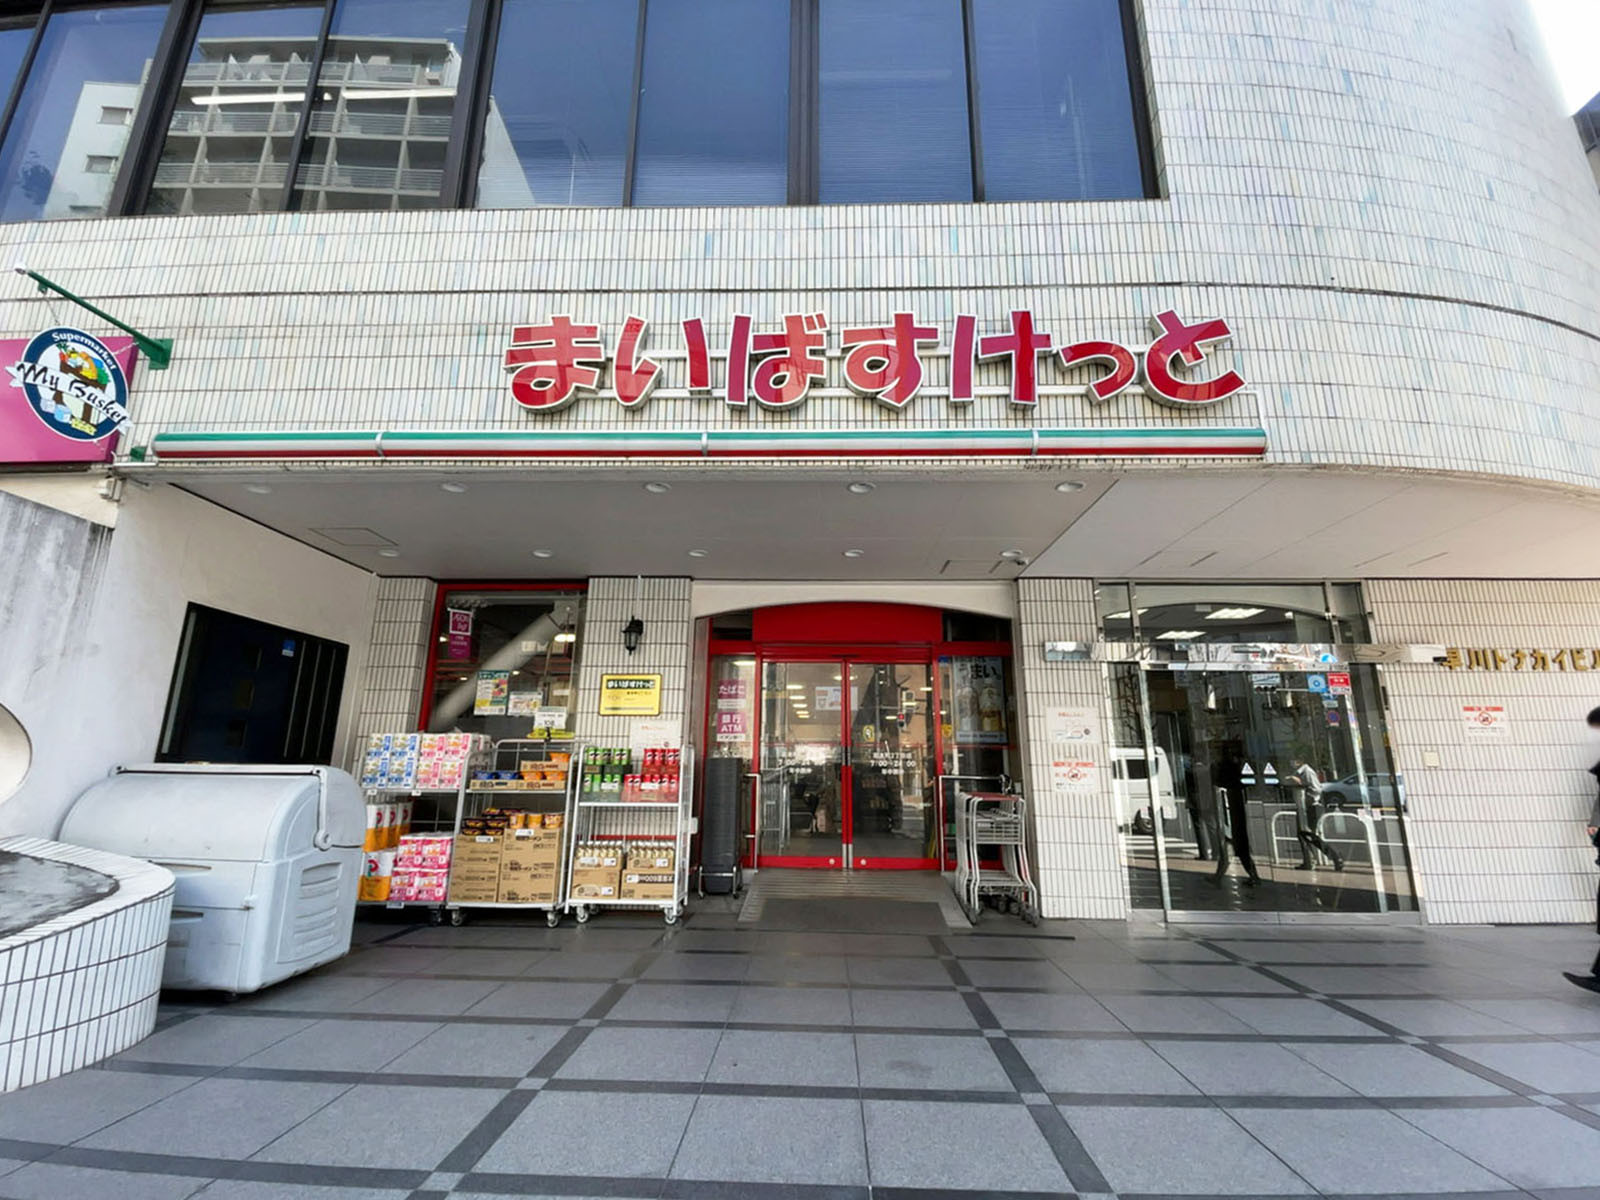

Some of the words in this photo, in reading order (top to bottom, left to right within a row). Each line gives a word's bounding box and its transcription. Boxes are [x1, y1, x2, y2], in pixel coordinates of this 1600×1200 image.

[51, 331, 118, 371] Supermarket
[505, 308, 1247, 413] まいばすけっと
[16, 362, 60, 391] My
[69, 380, 130, 424] Basket
[718, 685, 745, 695] たばこ
[721, 714, 741, 724] 銀行
[721, 724, 742, 733] ATM
